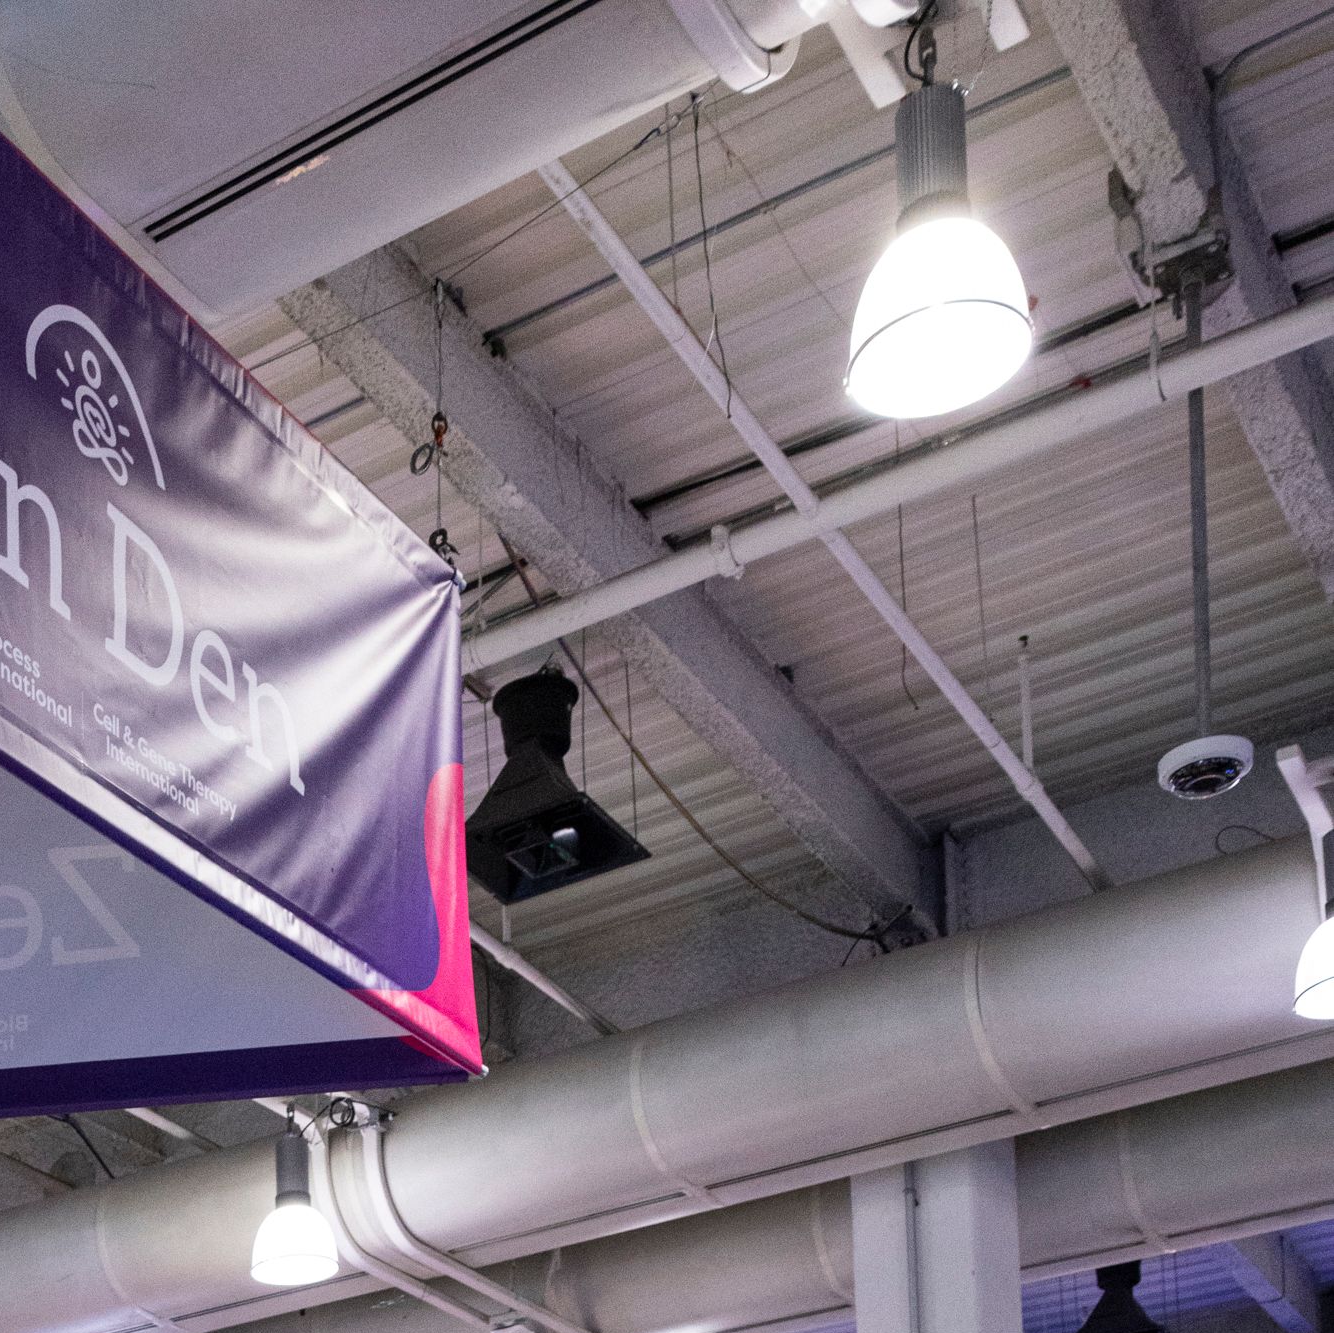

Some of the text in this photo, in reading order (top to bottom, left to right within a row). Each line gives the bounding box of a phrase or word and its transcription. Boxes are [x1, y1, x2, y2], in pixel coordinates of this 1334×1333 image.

[104, 502, 306, 796] Den
[93, 702, 238, 821] Cell & Gene Therapy
[106, 734, 200, 816] International
